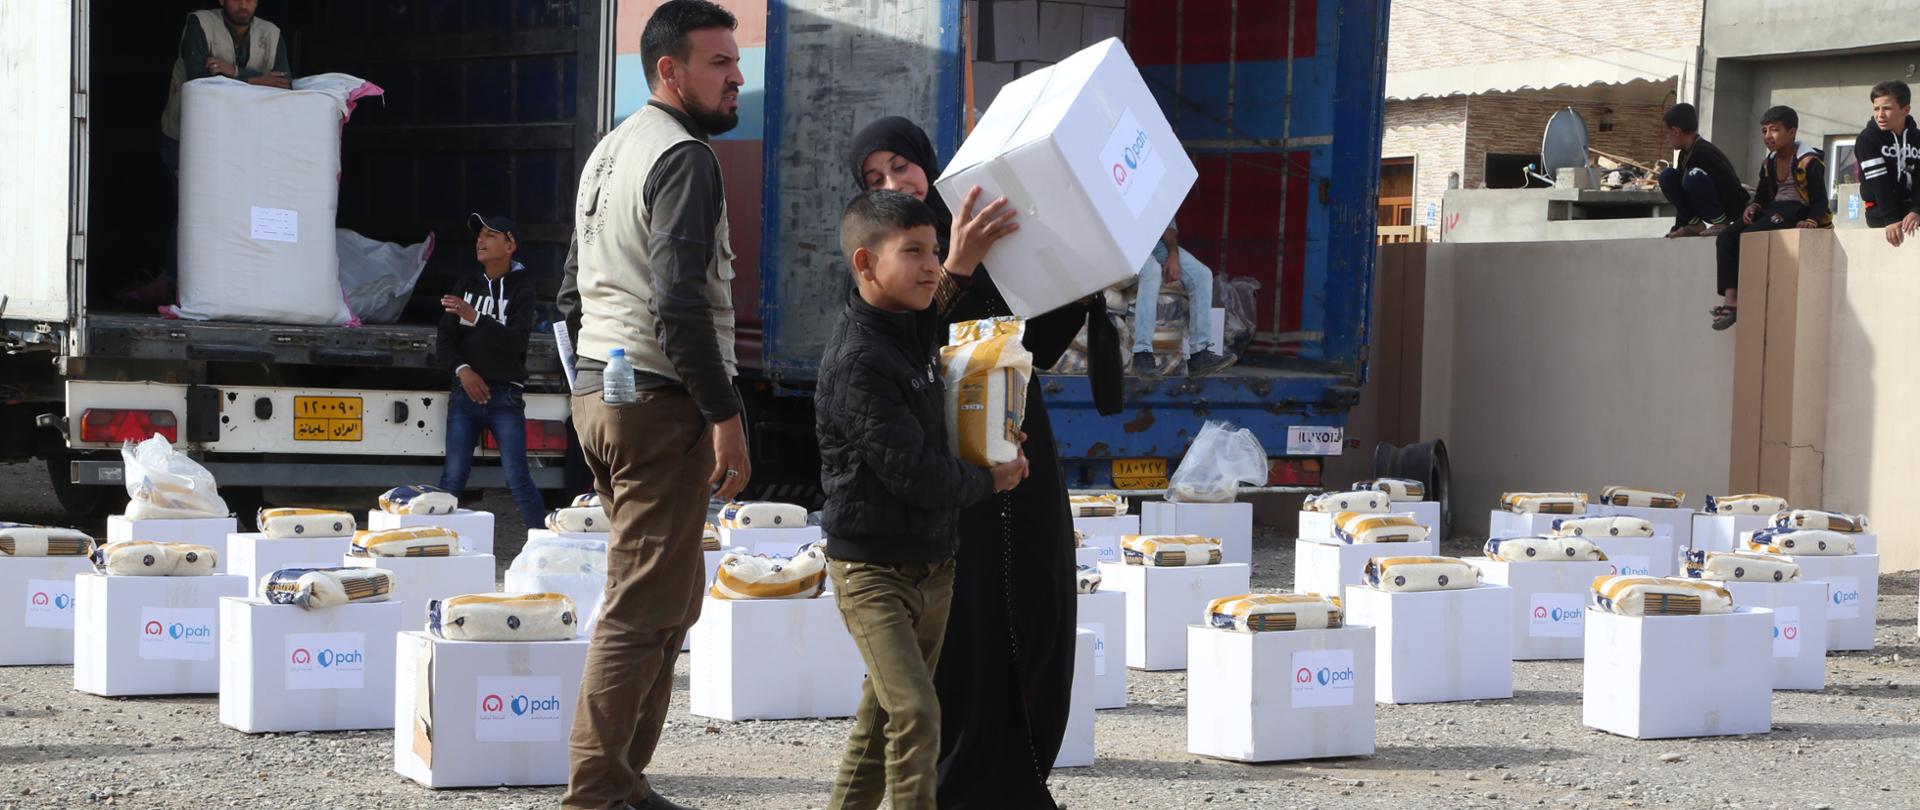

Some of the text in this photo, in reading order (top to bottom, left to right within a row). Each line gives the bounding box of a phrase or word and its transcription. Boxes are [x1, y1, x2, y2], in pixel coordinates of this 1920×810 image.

[1132, 129, 1148, 160] pah
[303, 400, 355, 414] ١٢٠٠٩٠
[1843, 590, 1859, 603] pah
[1563, 608, 1582, 621] pah
[185, 625, 210, 640] pah
[335, 649, 362, 666] pah
[1332, 667, 1354, 684] pah
[531, 695, 560, 714] pah
